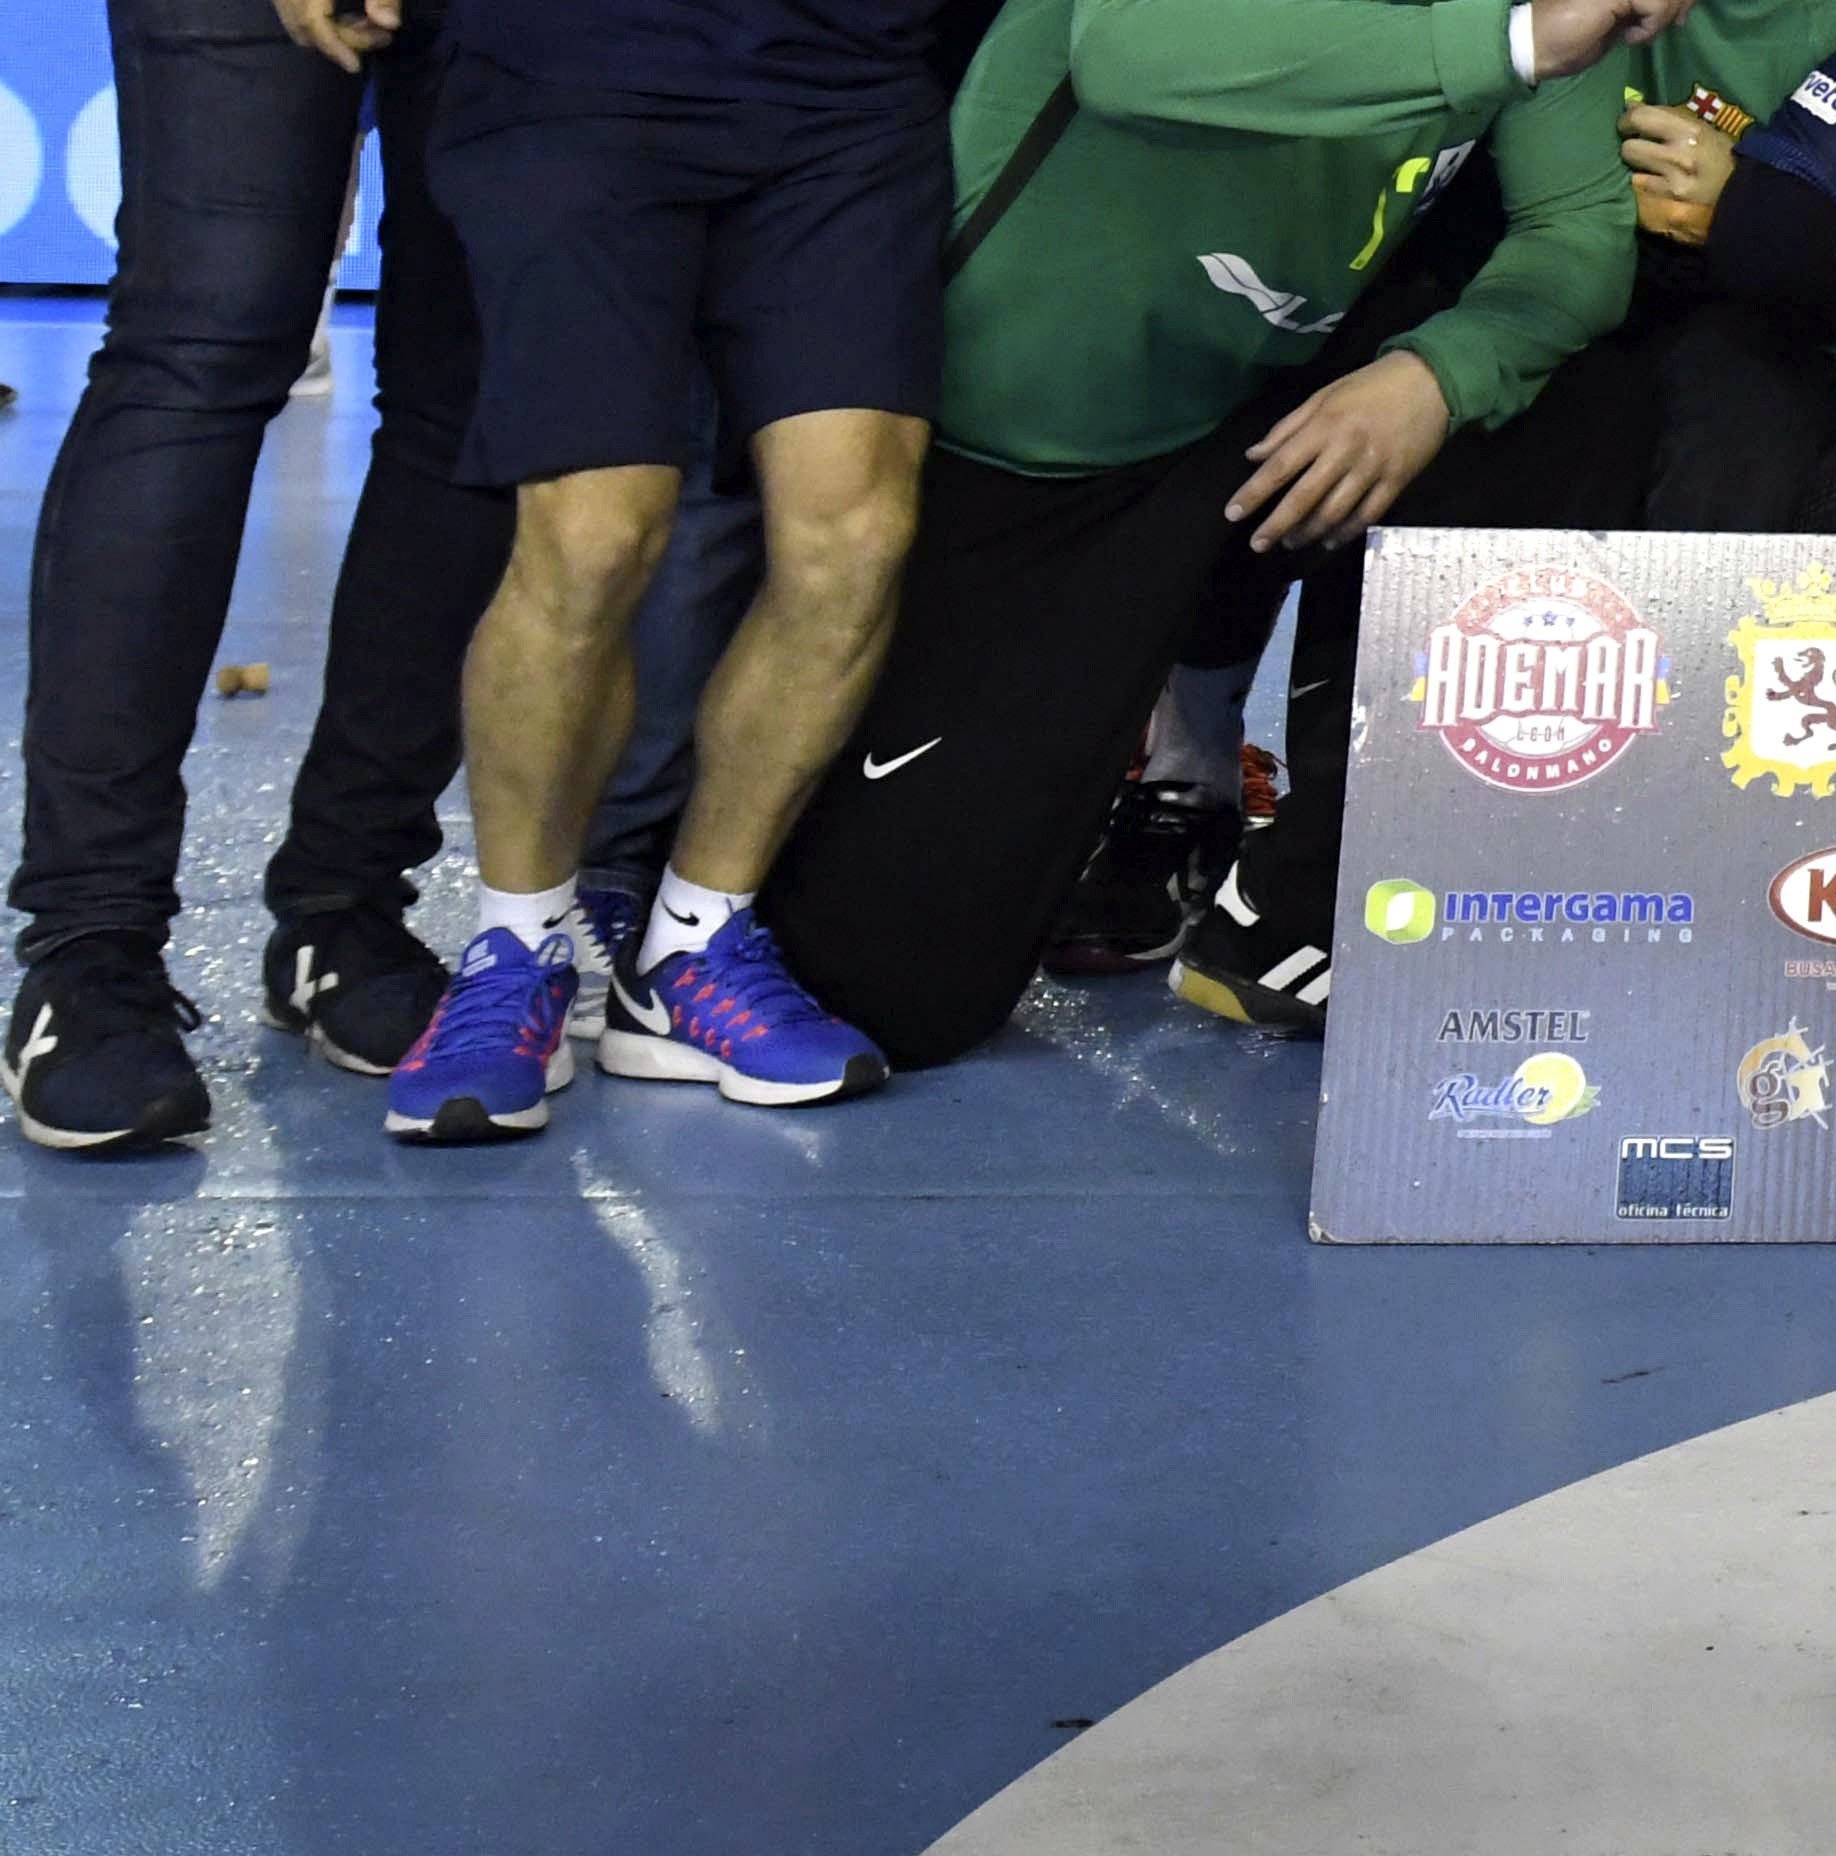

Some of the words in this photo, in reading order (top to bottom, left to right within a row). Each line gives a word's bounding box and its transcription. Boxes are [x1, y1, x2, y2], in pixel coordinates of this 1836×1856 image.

[1423, 623, 1659, 730] ADEMAR
[1460, 737, 1613, 782] BALONMANO
[1440, 927, 1693, 943] PACKAGING
[1438, 1010, 1589, 1043] AMSTEL
[1617, 1203, 1669, 1218] oficina
[1675, 1200, 1730, 1218] técnica
